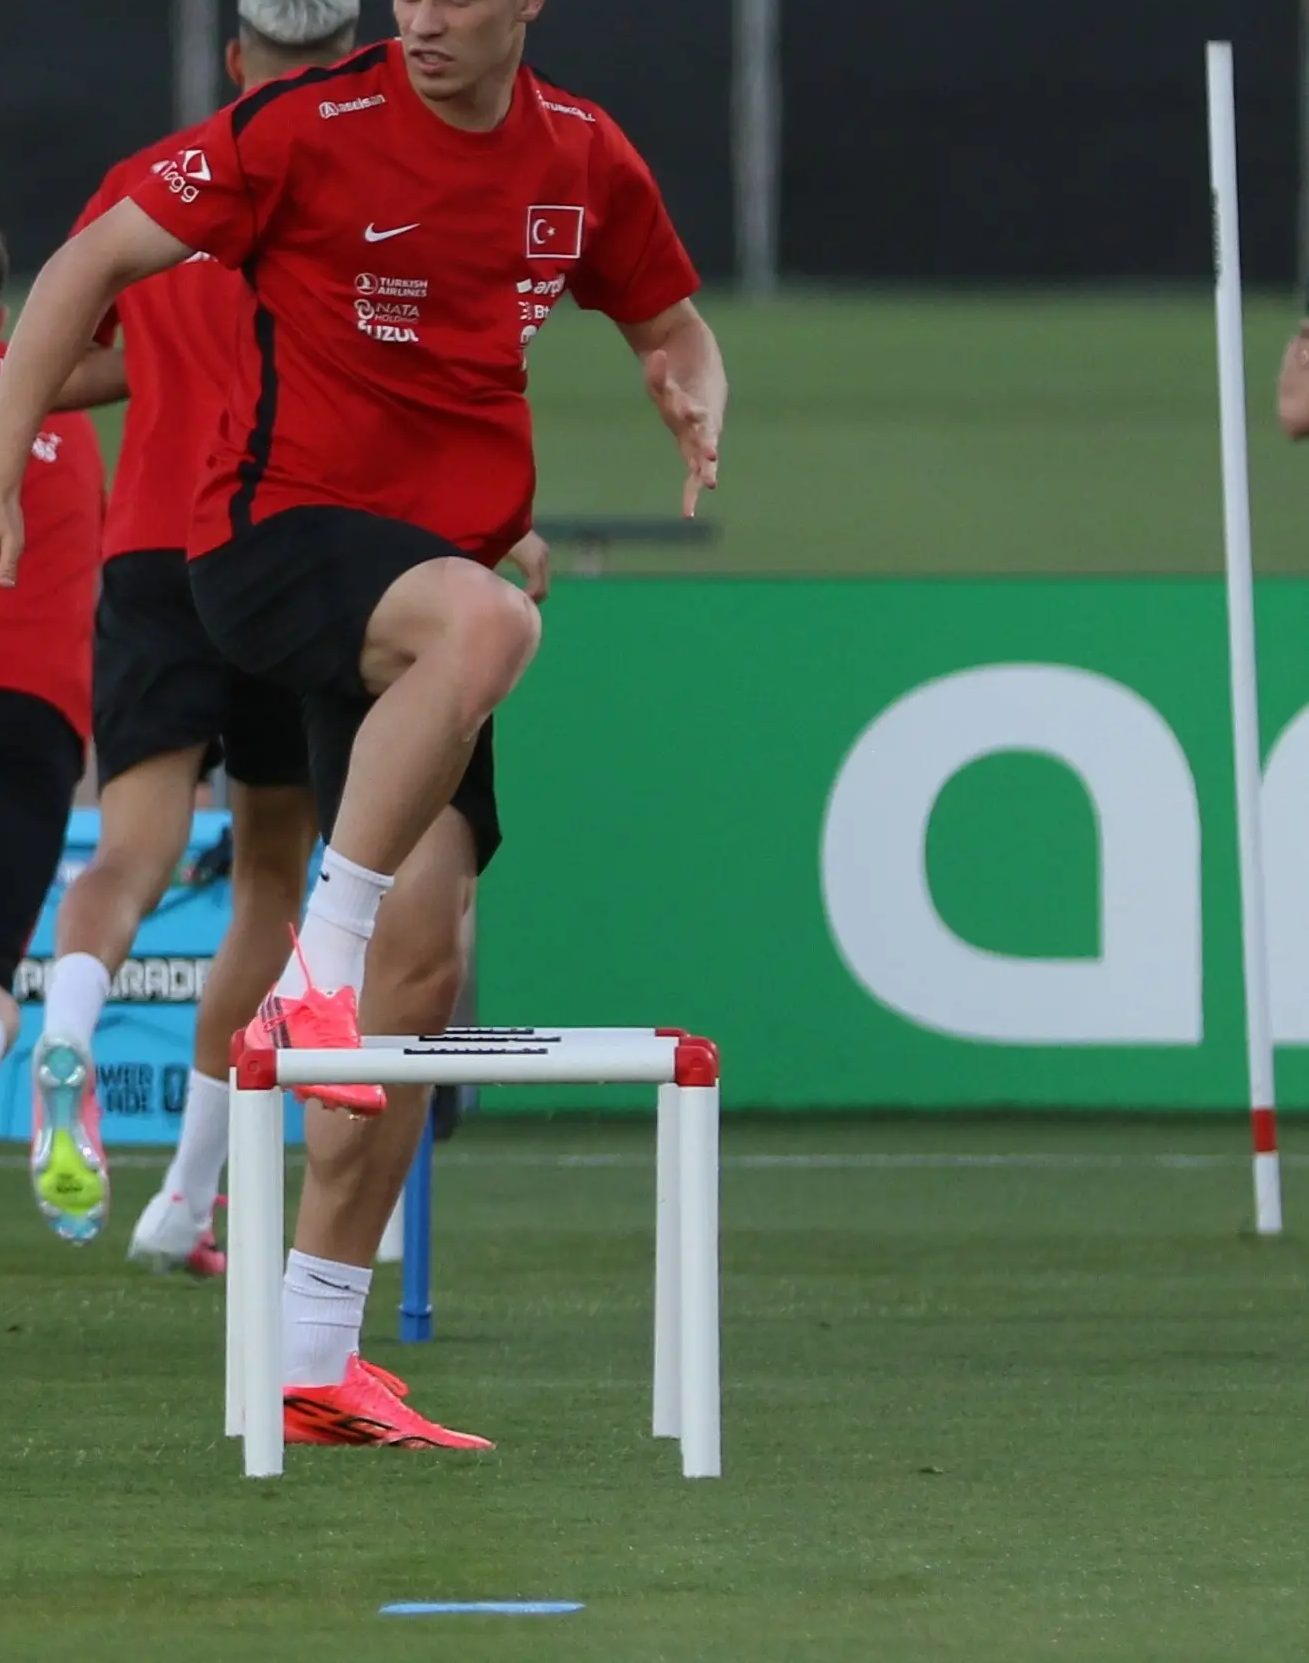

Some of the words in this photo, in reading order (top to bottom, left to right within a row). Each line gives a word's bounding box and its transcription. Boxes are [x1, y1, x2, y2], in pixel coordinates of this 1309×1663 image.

[160, 161, 200, 203] Togg
[378, 277, 428, 289] TURKISH
[377, 286, 427, 298] AIRLINES
[375, 302, 420, 318] NATA
